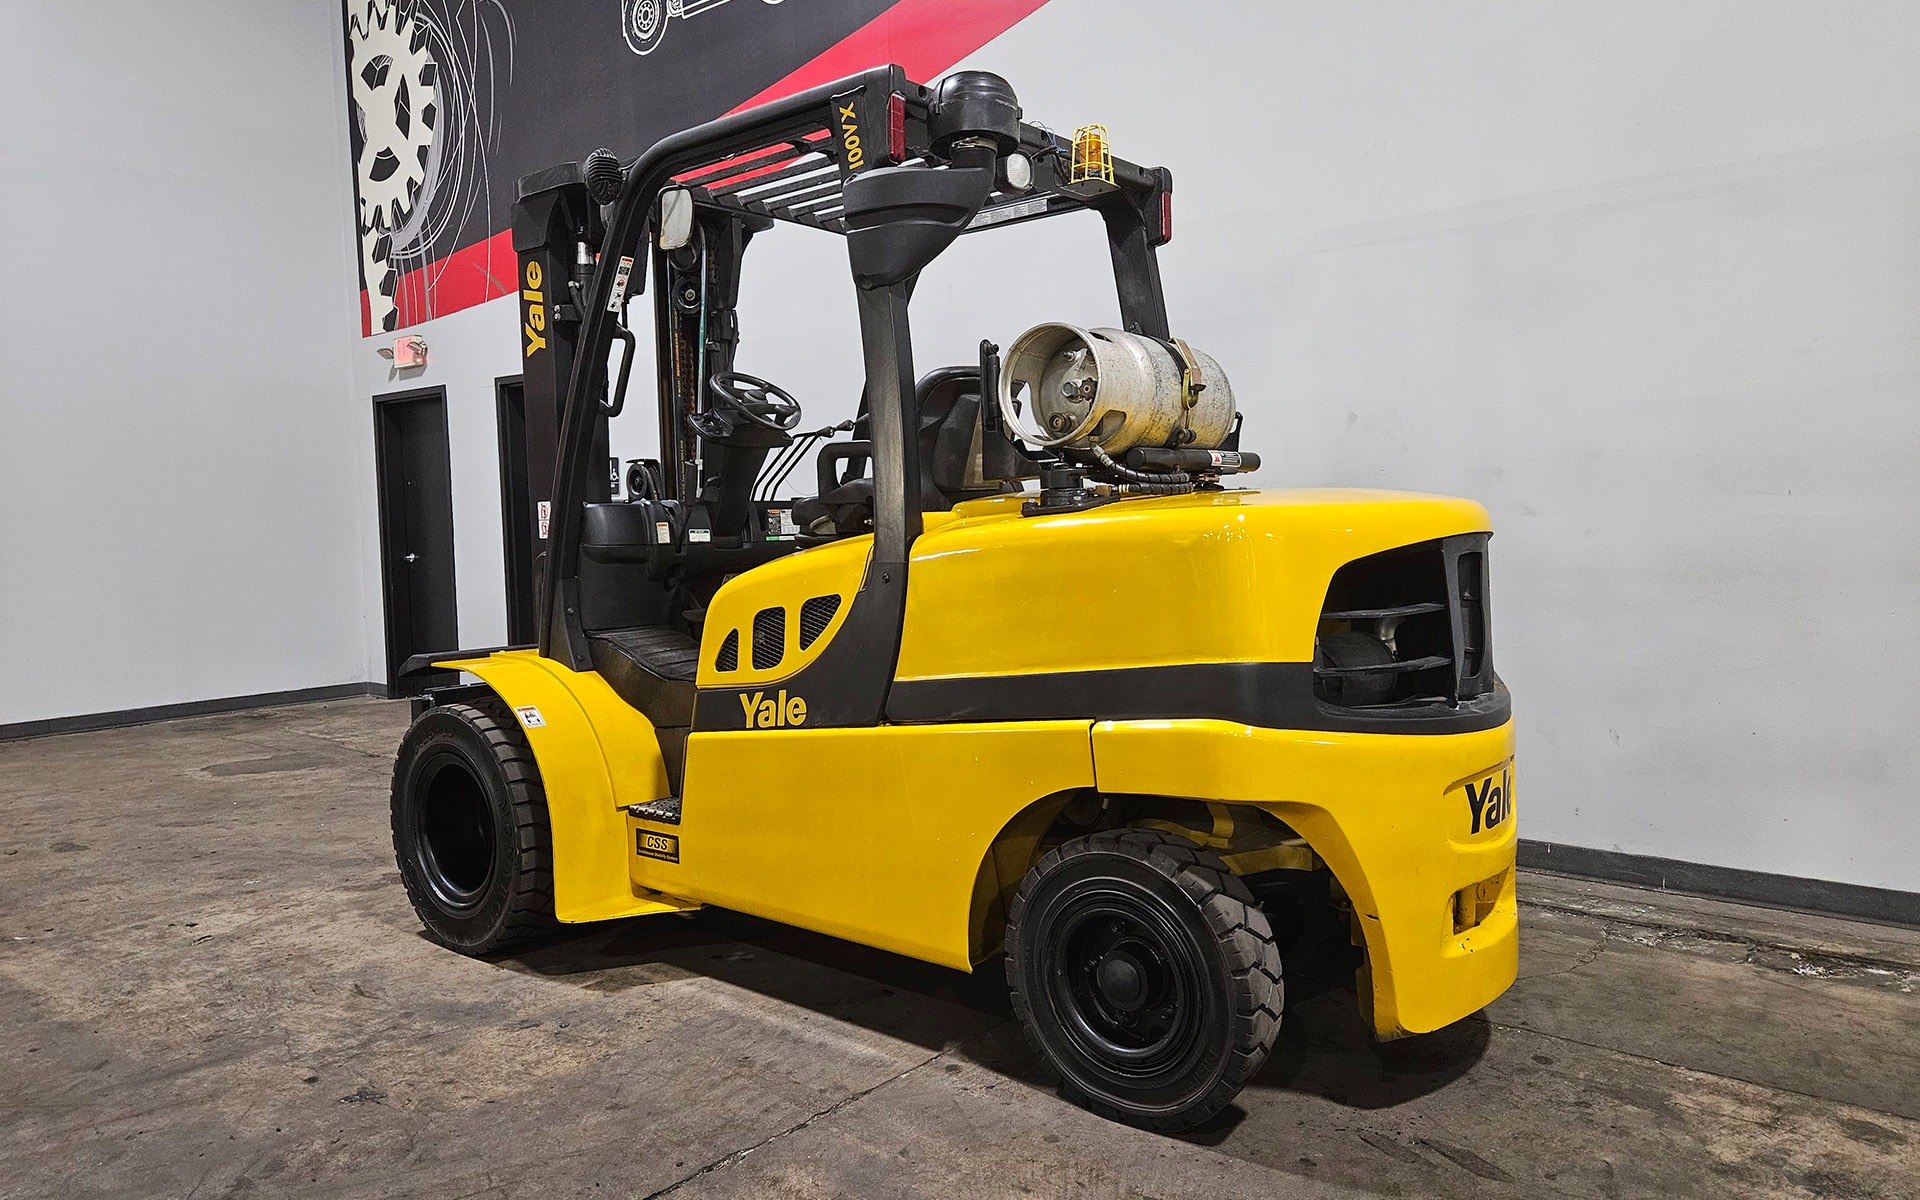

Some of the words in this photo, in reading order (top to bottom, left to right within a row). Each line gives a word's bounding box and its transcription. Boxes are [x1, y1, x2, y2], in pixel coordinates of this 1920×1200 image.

[839, 101, 864, 170] 100VX
[523, 260, 546, 358] Yale
[739, 690, 807, 728] Yale
[1464, 769, 1512, 835] Yale
[647, 836, 668, 851] CSS
